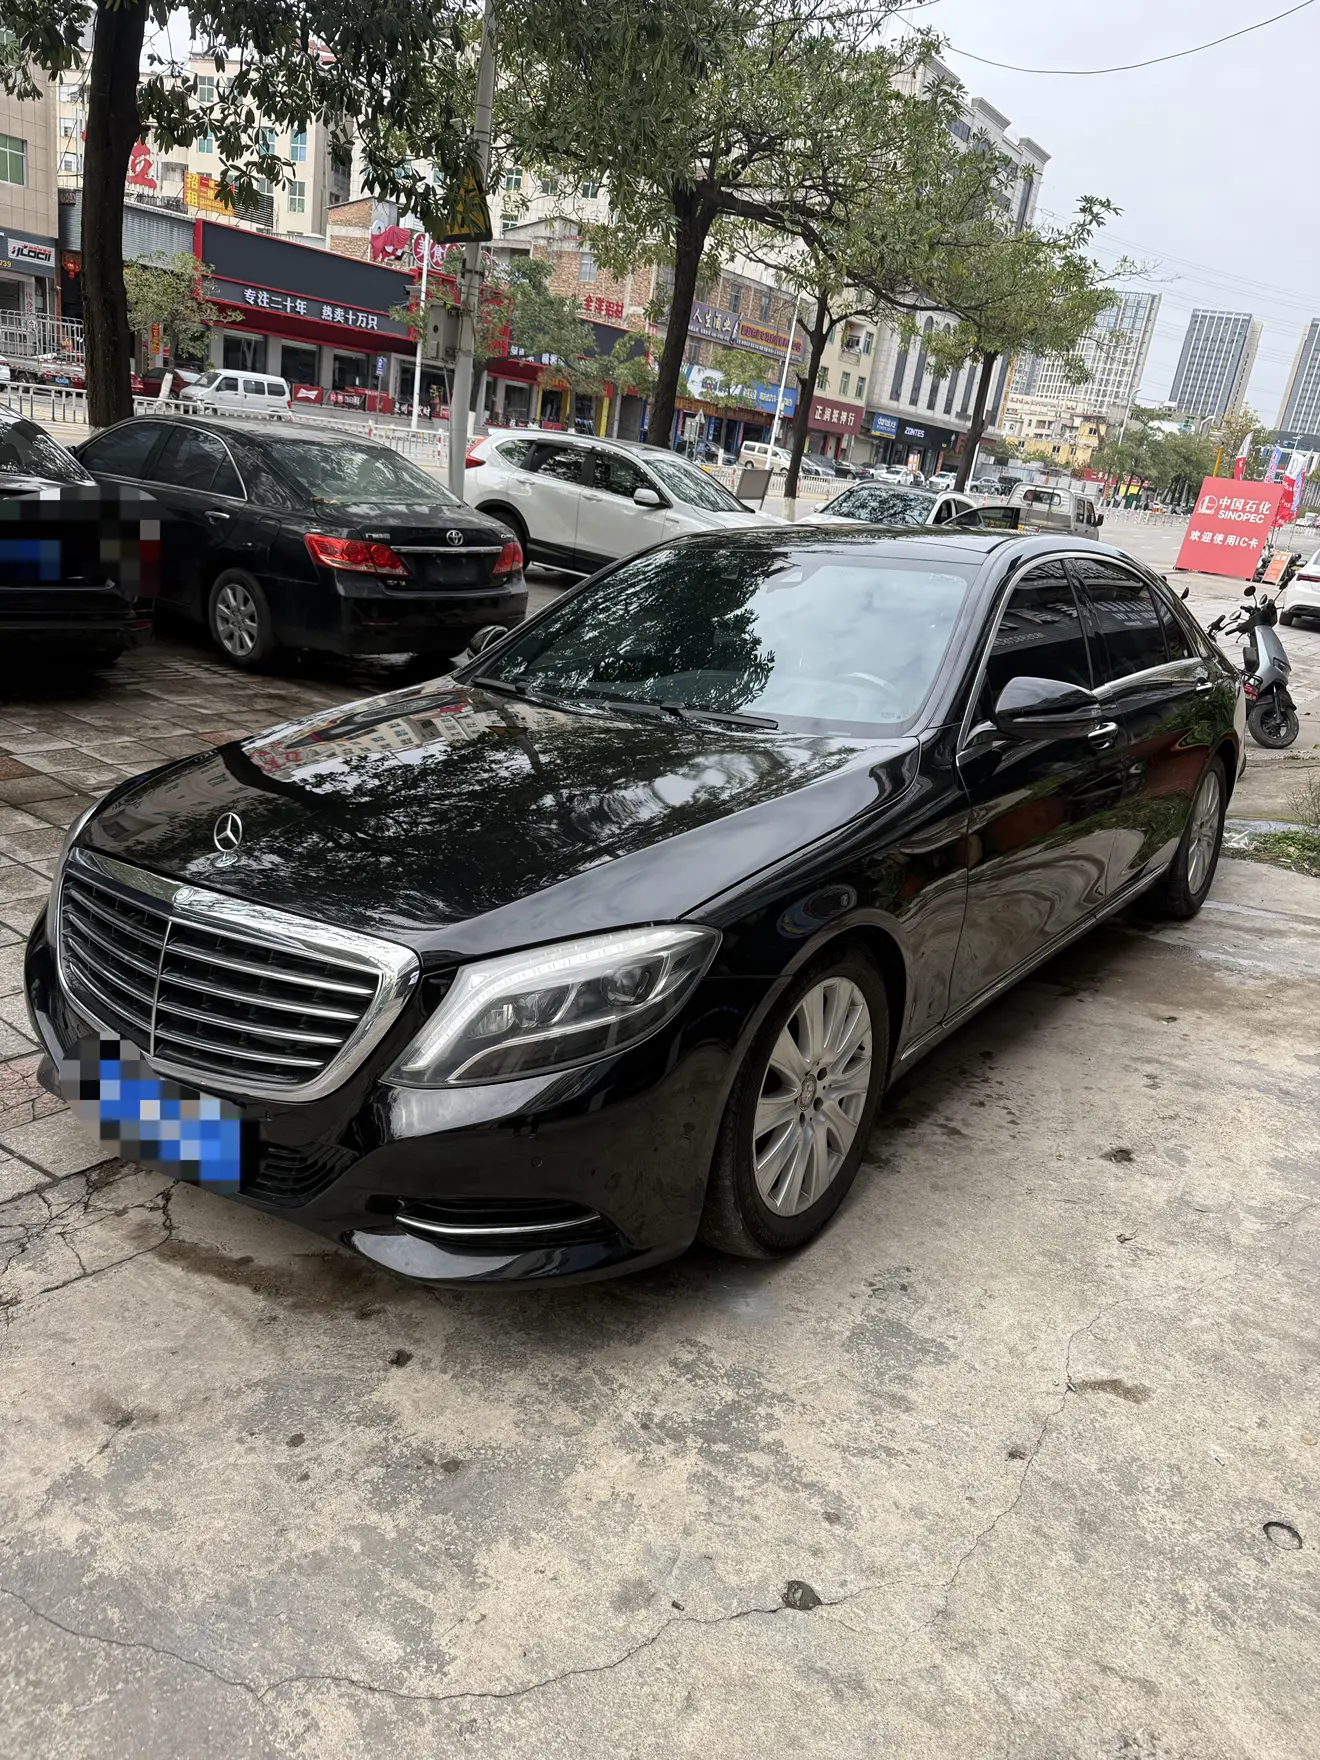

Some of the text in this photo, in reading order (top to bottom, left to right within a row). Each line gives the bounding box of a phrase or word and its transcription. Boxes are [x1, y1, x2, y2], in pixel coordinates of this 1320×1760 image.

[243, 288, 307, 315] 专注二十年
[321, 304, 378, 330] 热卖十万只
[904, 426, 925, 438] ZONTES
[1219, 496, 1272, 515] 中国石化
[1217, 509, 1265, 524] SINOPEC
[1189, 530, 1259, 549] 欢迎使用IC卡
